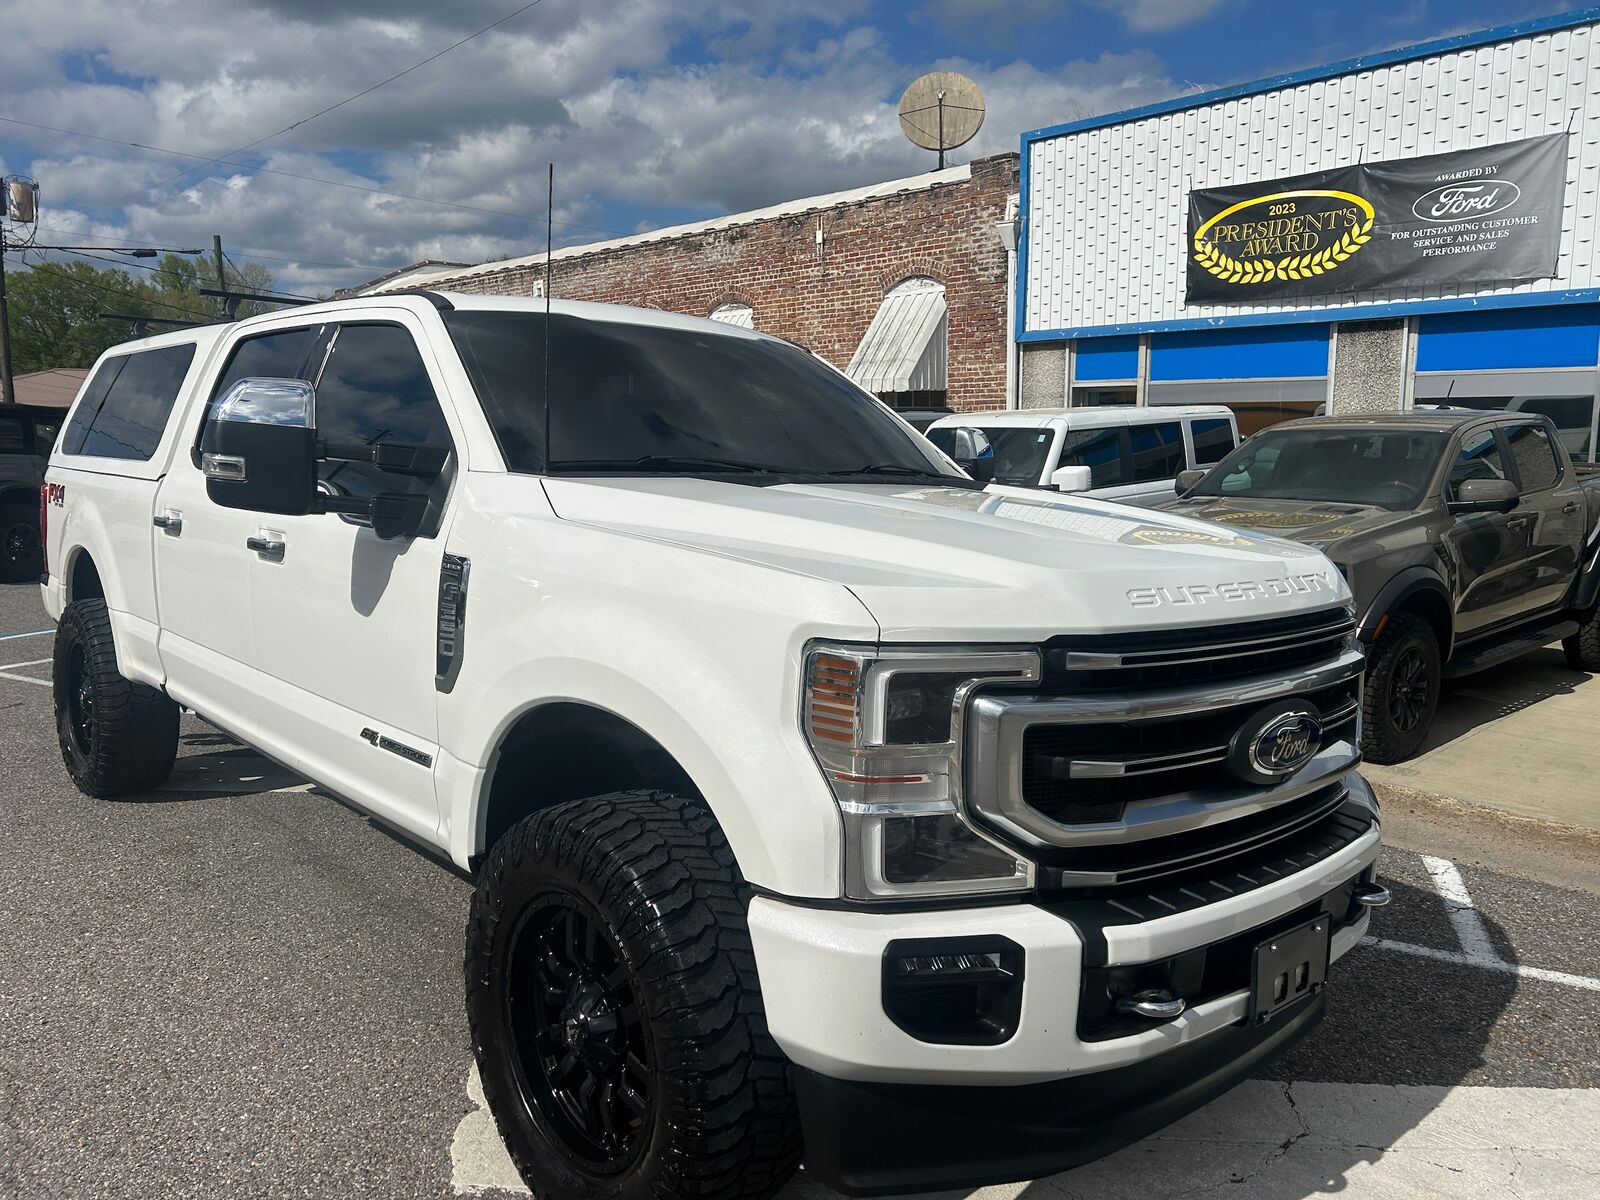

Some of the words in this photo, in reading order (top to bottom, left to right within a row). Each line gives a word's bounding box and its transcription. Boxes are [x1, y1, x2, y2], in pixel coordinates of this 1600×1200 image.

[1435, 167, 1482, 182] AWARDED
[1485, 165, 1499, 176] BY
[1269, 202, 1296, 216] 2023
[1431, 185, 1499, 217] Ford
[1212, 207, 1358, 244] PRESIDENT'S
[1390, 231, 1410, 240] FOR
[1412, 221, 1479, 238] OUTSTANDING
[1482, 215, 1539, 230] CUSTOMER
[1239, 232, 1319, 258] AWARD
[1413, 236, 1454, 248] SERVICE
[1456, 232, 1477, 243] AND
[1479, 229, 1510, 241] SALES
[1422, 241, 1497, 257] PERFORMANCE
[1126, 580, 1269, 609] SUPER
[1265, 571, 1333, 597] DUTY
[402, 746, 430, 763] STROKE
[1271, 724, 1310, 763] Ford
